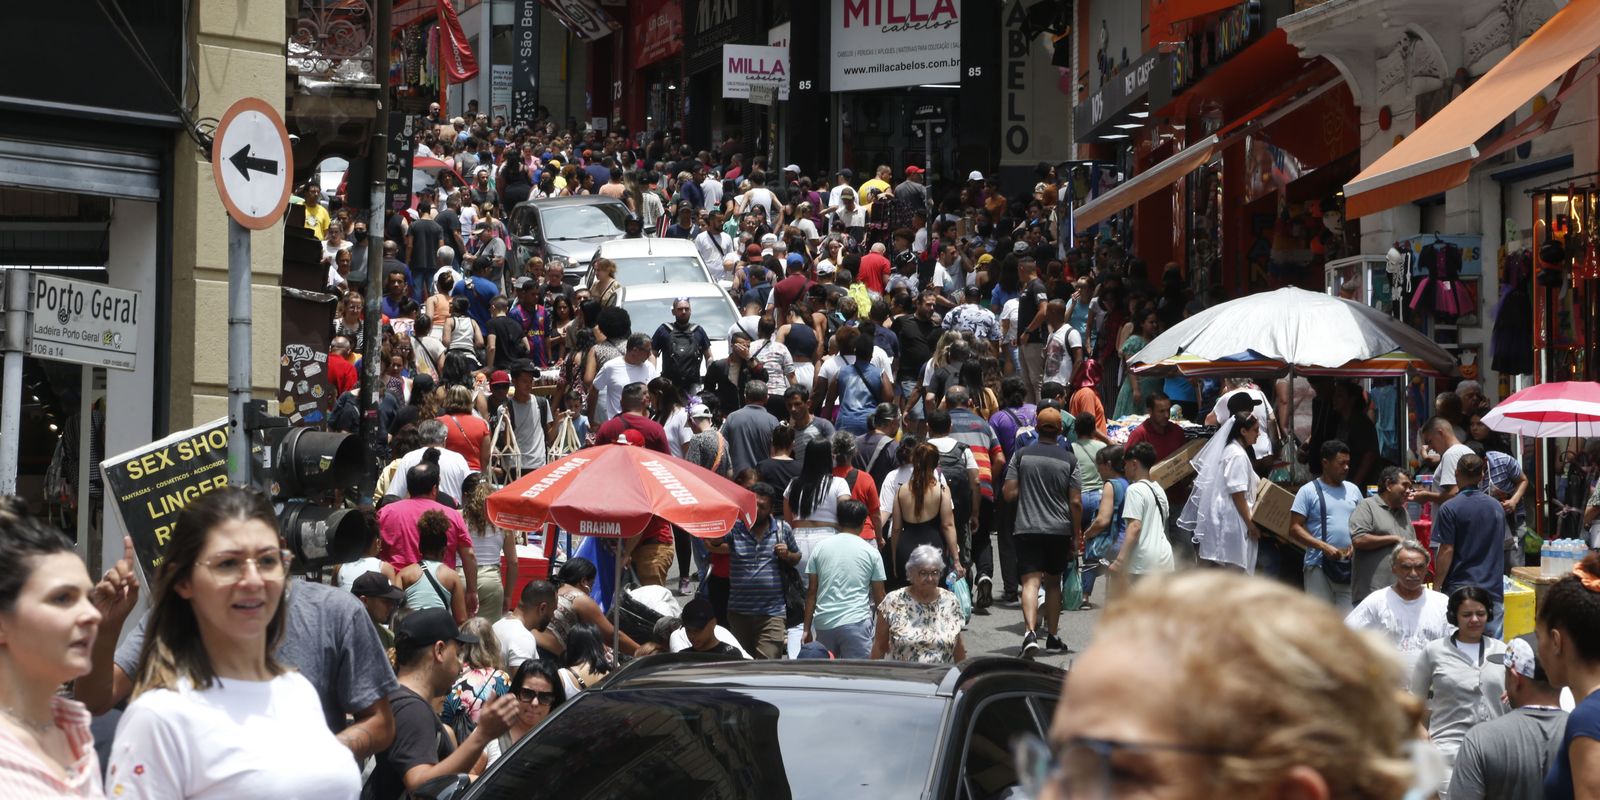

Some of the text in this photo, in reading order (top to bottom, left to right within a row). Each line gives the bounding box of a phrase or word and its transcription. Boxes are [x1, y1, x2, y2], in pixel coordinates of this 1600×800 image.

[843, 0, 958, 28] MILLA
[881, 13, 959, 34] cabelos
[521, 31, 534, 57] São
[728, 57, 785, 75] MILLA
[843, 57, 961, 75] www.millacabelos.com.br
[968, 67, 982, 77] 85
[613, 80, 622, 100] 73
[798, 80, 812, 90] 85
[36, 279, 138, 325] Porto Geral
[34, 323, 100, 342] Ladeira Porto Geral
[33, 344, 47, 354] 106
[55, 347, 64, 357] 14
[126, 448, 176, 480] SEX
[520, 457, 592, 500] BRAHMA
[640, 460, 699, 506] BRAHMA
[121, 486, 152, 502] FANTASIAS
[579, 520, 622, 535] BRAHMA
